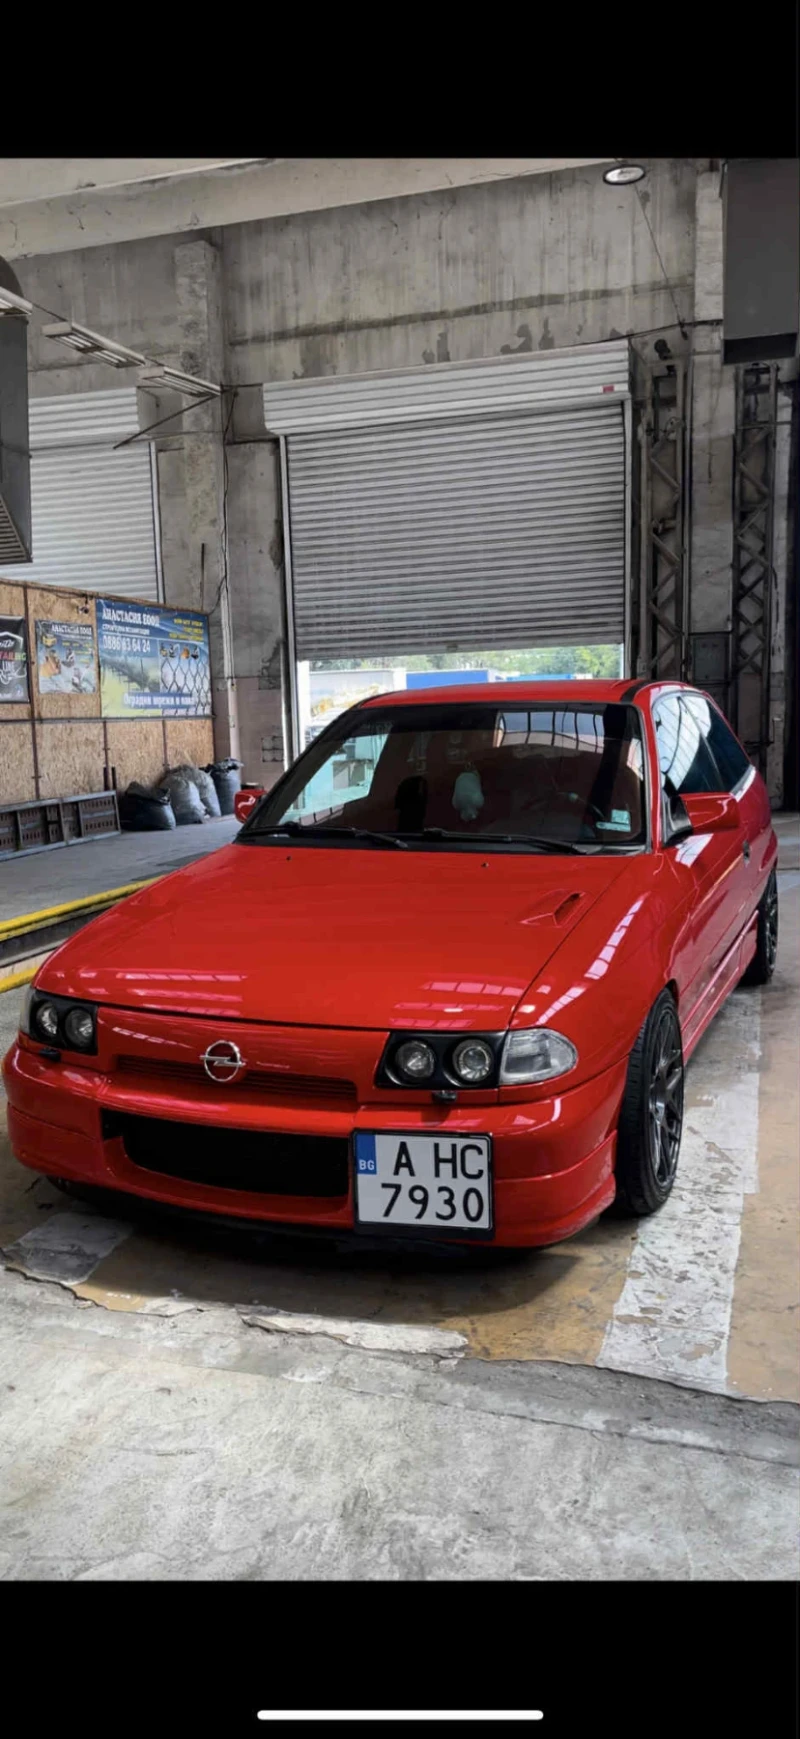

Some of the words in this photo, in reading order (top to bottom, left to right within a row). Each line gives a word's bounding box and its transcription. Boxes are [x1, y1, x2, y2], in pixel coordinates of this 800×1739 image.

[358, 1159, 375, 1171] BG
[393, 1141, 416, 1177] A
[433, 1142, 484, 1180] HC
[381, 1182, 484, 1223] 7930
